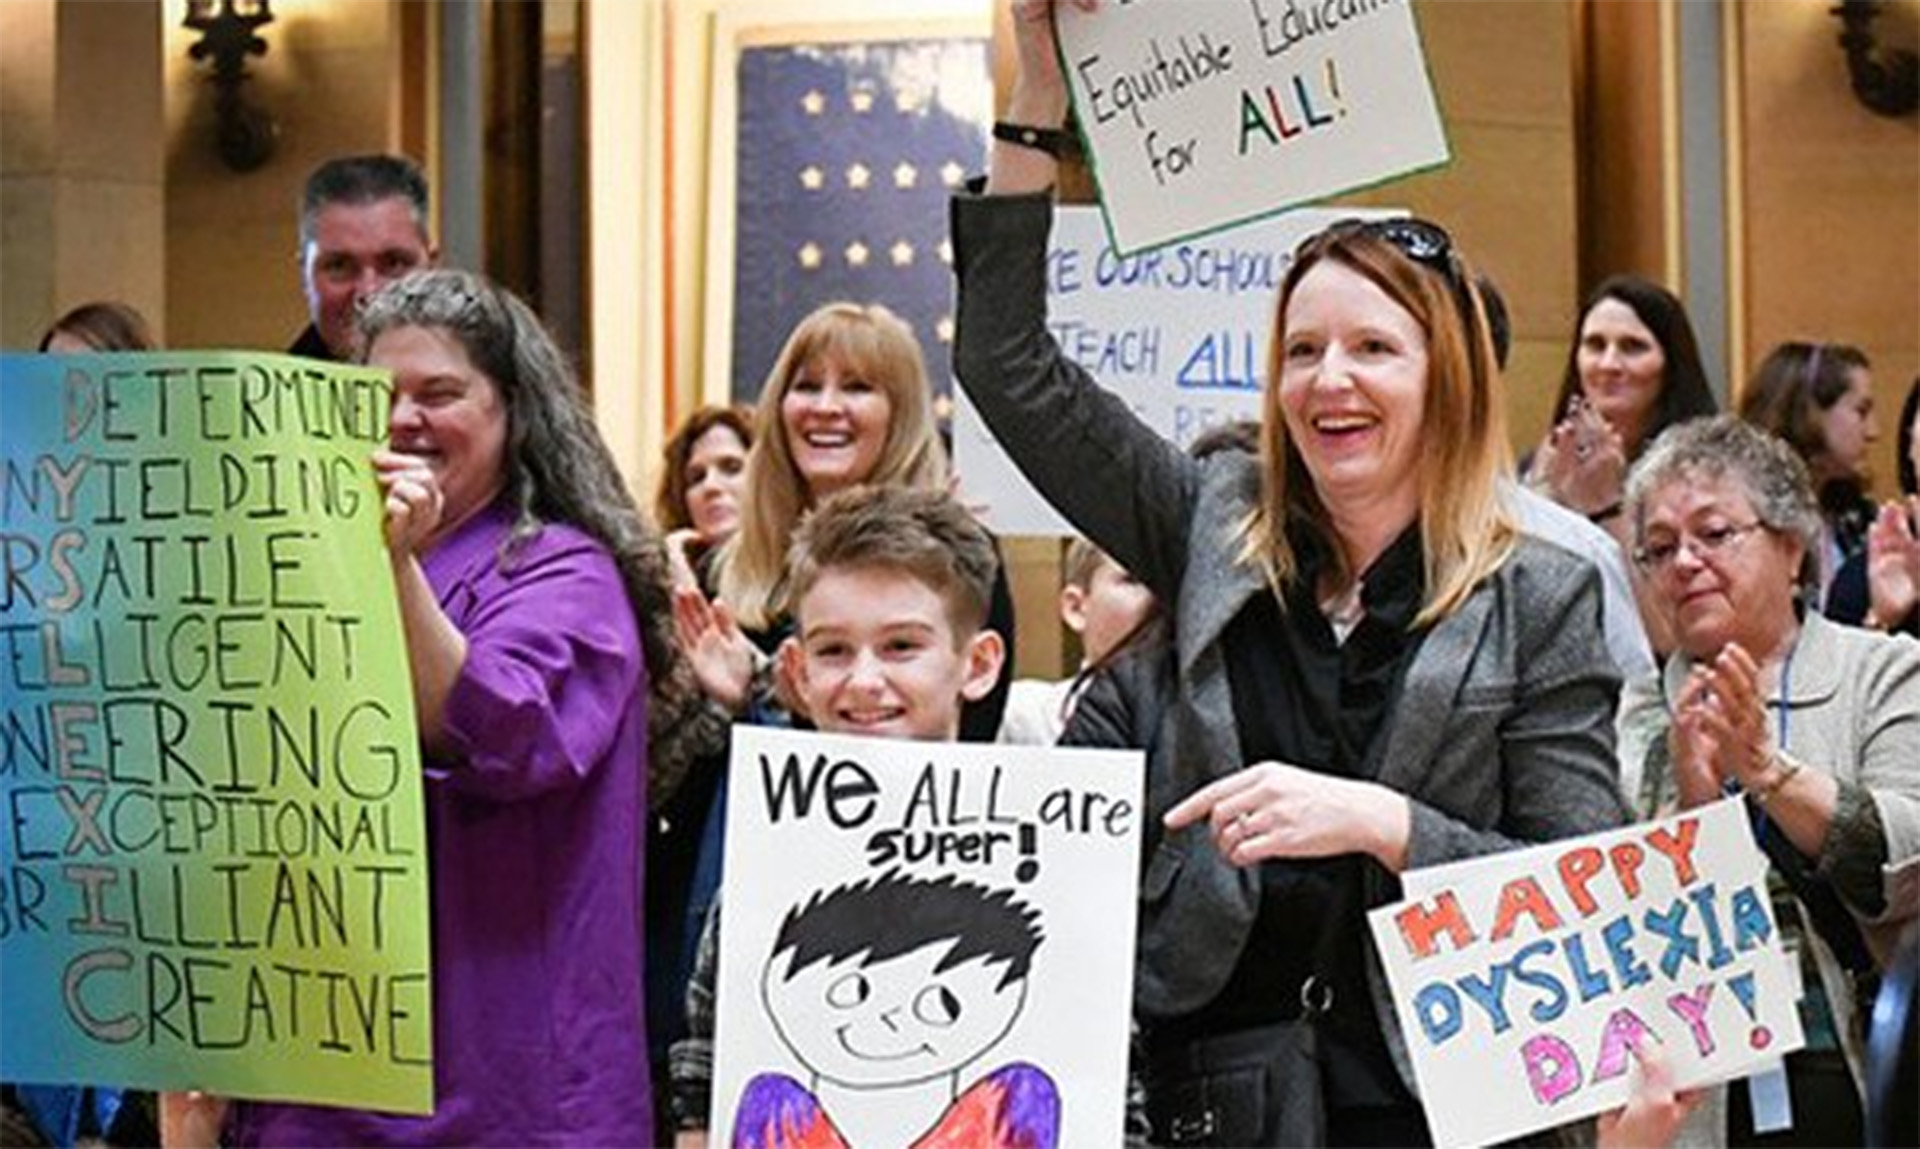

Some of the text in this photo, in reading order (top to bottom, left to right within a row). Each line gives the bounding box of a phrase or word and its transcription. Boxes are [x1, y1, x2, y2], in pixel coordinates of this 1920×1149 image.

[1078, 32, 1232, 128] Equitable
[1144, 58, 1347, 185] for ALL!
[64, 364, 392, 444] DETERMINED
[1052, 321, 1261, 393] TEACH ALL
[11, 785, 414, 860] EXCEPTIONAL
[759, 753, 1132, 837] We ALL are
[1394, 818, 1701, 960] HAPPY
[62, 948, 432, 1066] CREATIVE
[1412, 883, 1772, 1046] DYSLEXIA
[1519, 970, 1774, 1107] DAY!
